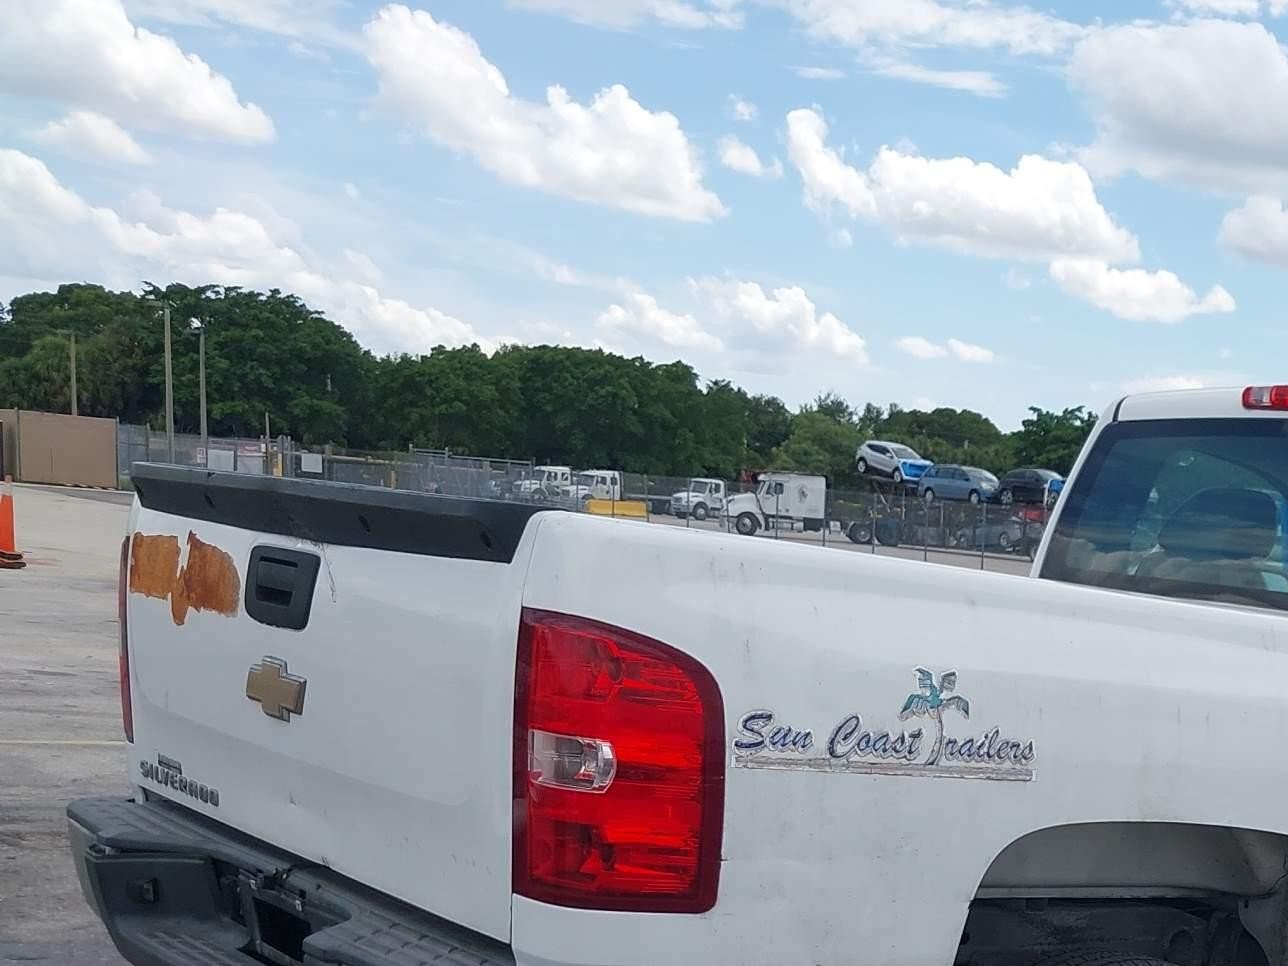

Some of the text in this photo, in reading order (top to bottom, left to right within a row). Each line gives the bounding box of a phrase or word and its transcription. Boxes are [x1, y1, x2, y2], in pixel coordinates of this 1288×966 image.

[734, 711, 815, 751] Sun
[827, 713, 924, 761] Coast
[140, 759, 220, 808] SILVERADO
